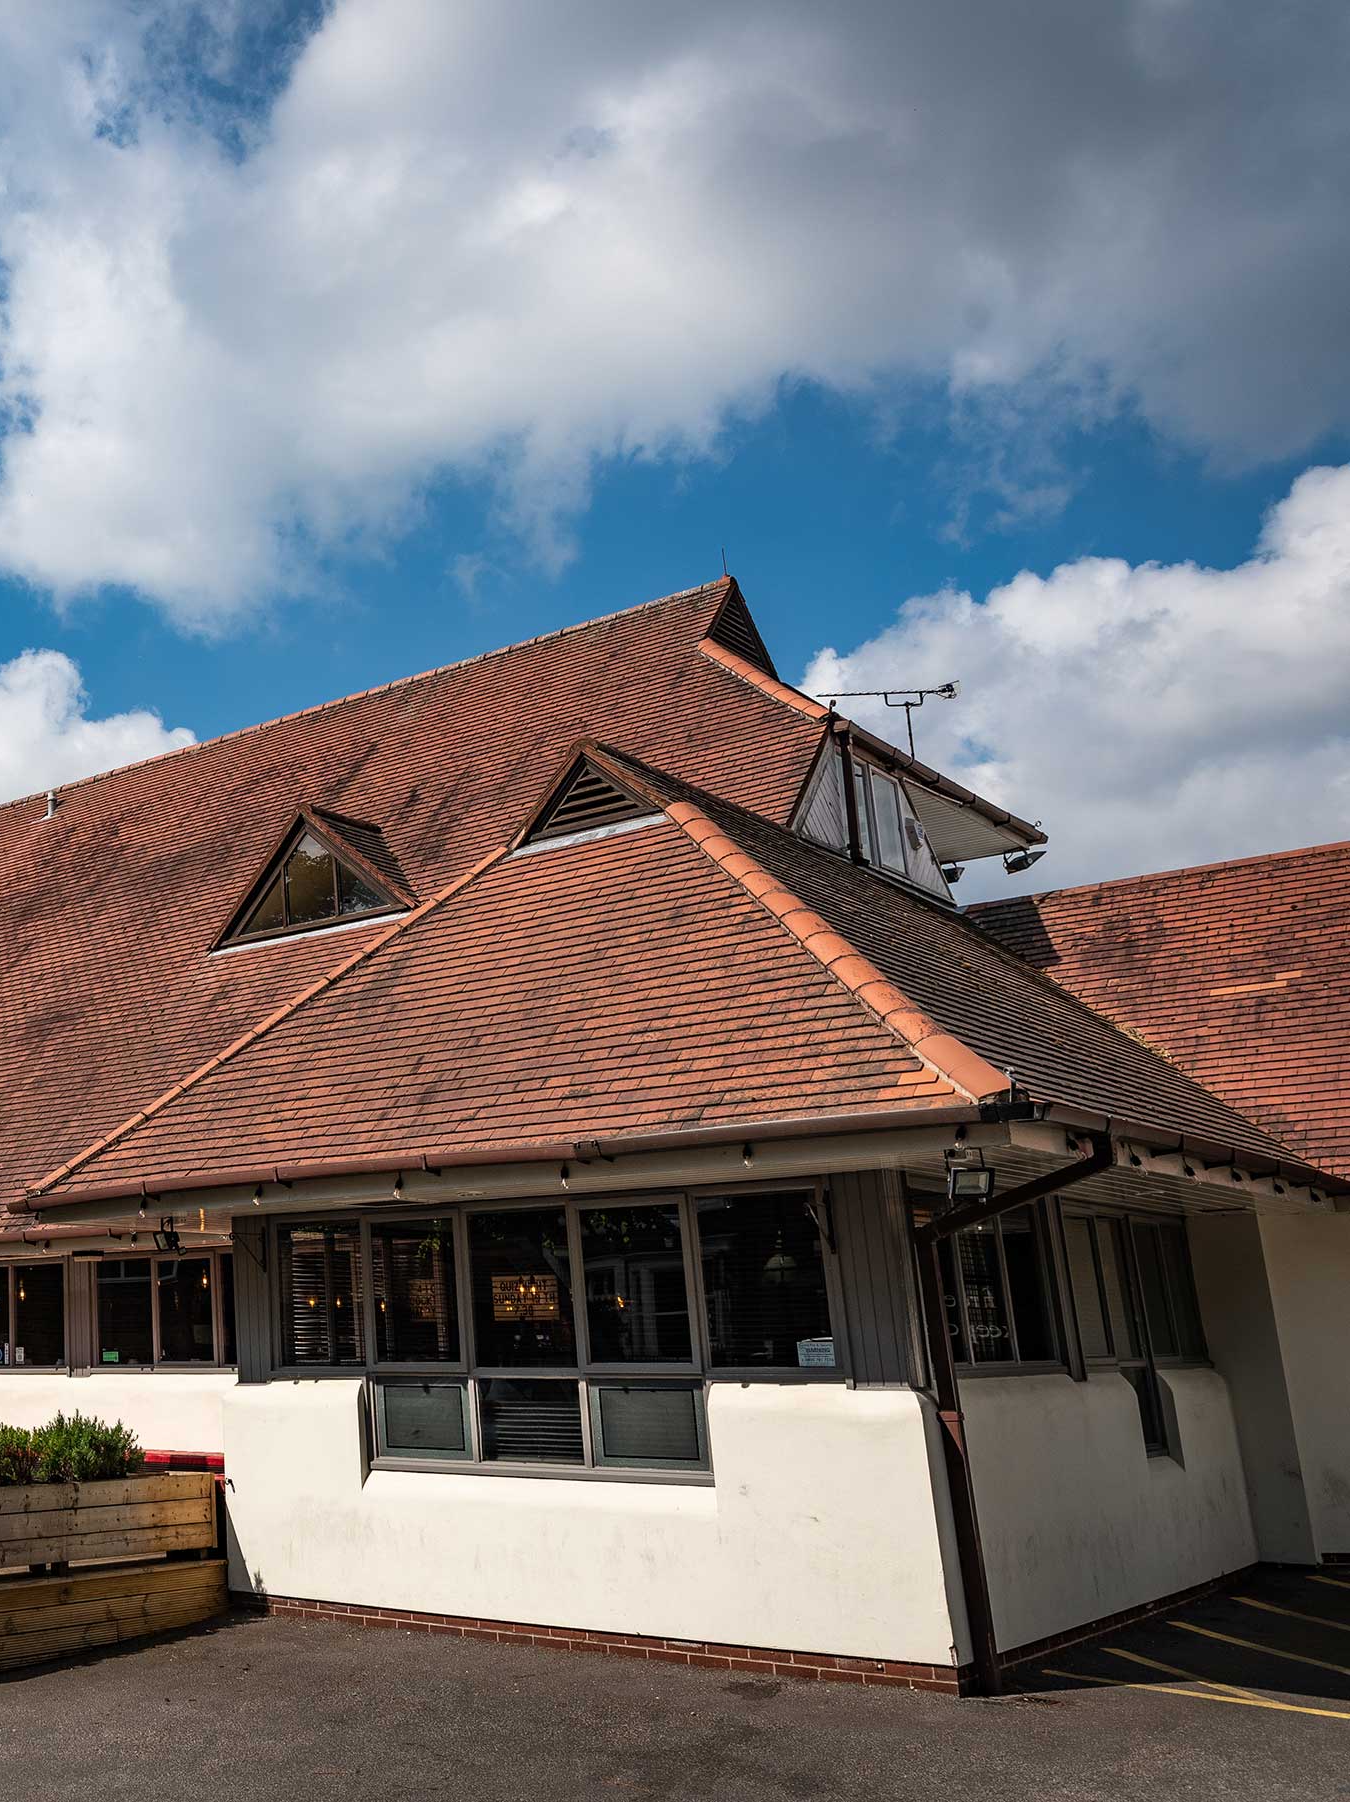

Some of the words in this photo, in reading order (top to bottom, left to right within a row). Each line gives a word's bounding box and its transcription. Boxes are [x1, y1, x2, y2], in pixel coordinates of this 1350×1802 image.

[500, 1281, 518, 1291] QUIZ
[522, 1280, 546, 1291] NIHT
[494, 1294, 527, 1304] SUNDAY
